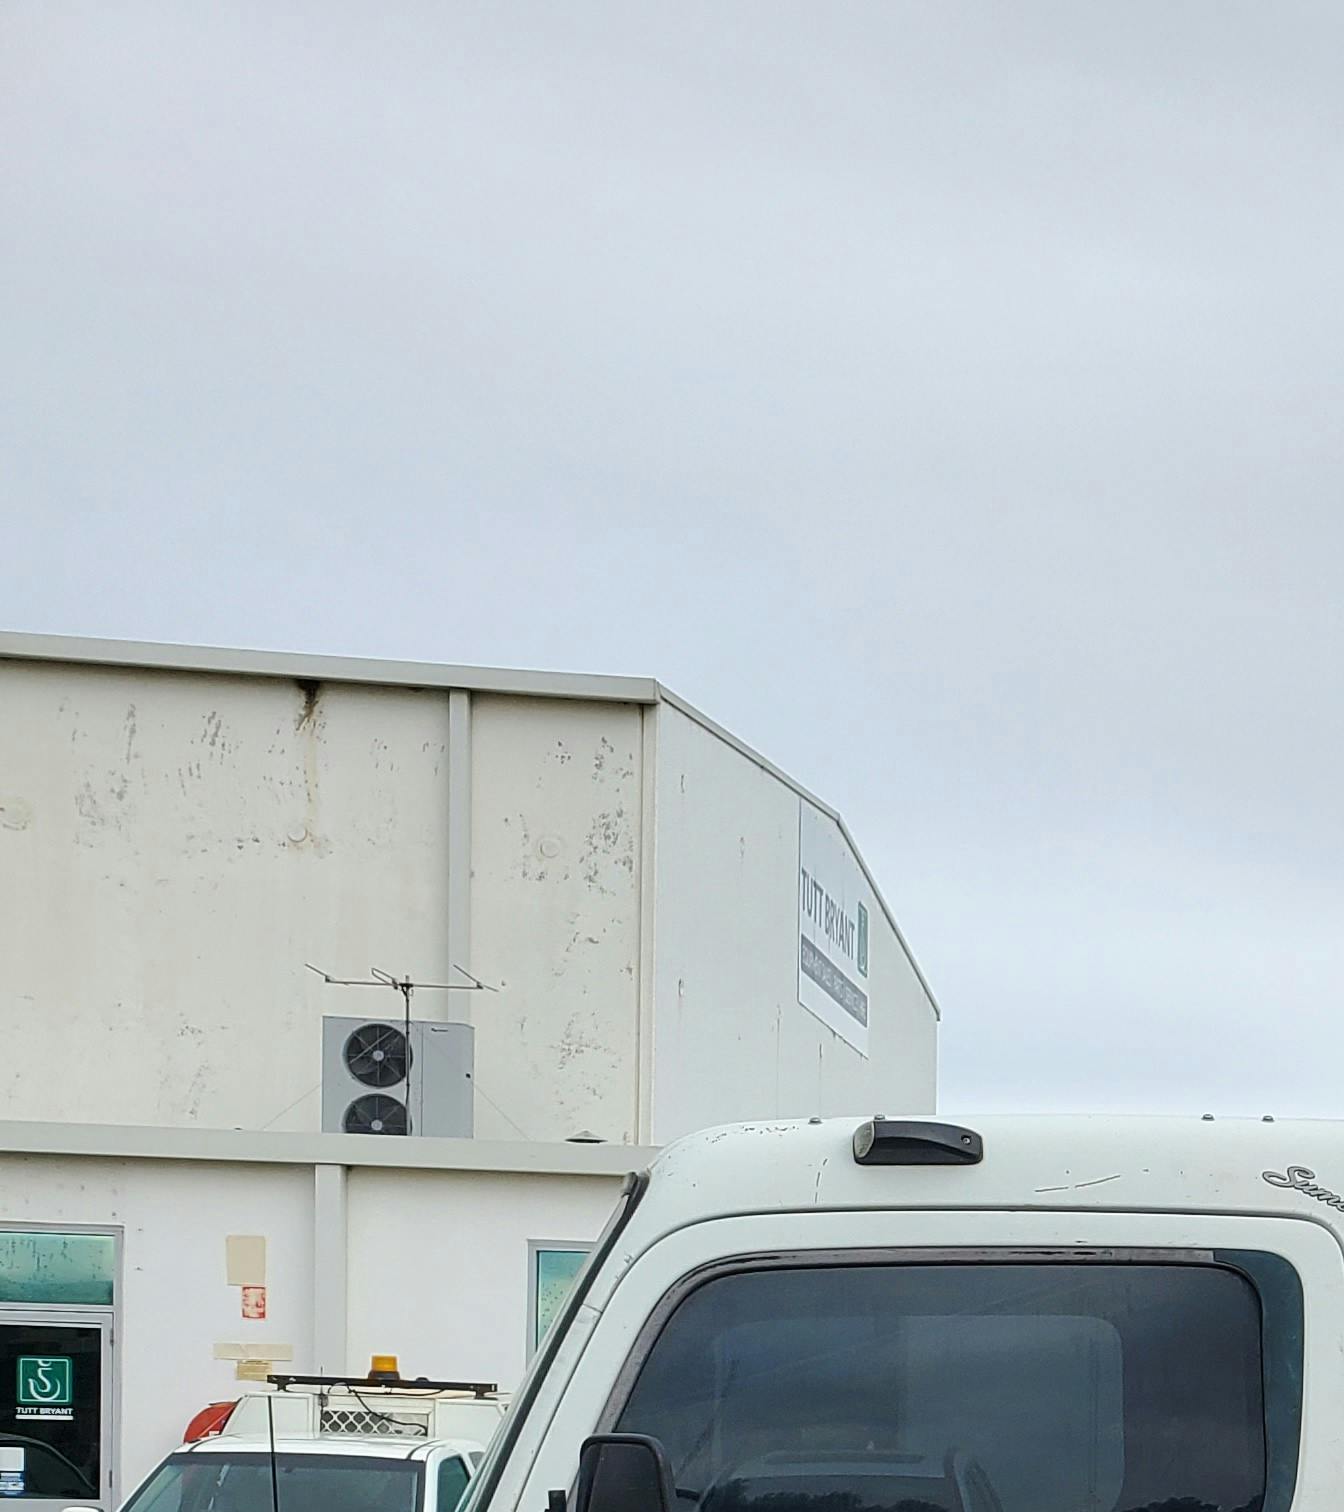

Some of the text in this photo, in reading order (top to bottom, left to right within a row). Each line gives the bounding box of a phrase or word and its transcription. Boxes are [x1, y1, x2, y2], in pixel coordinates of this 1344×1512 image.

[801, 866, 855, 960] TUTT BRYANT
[16, 1406, 73, 1415] TUTT BRYANT
